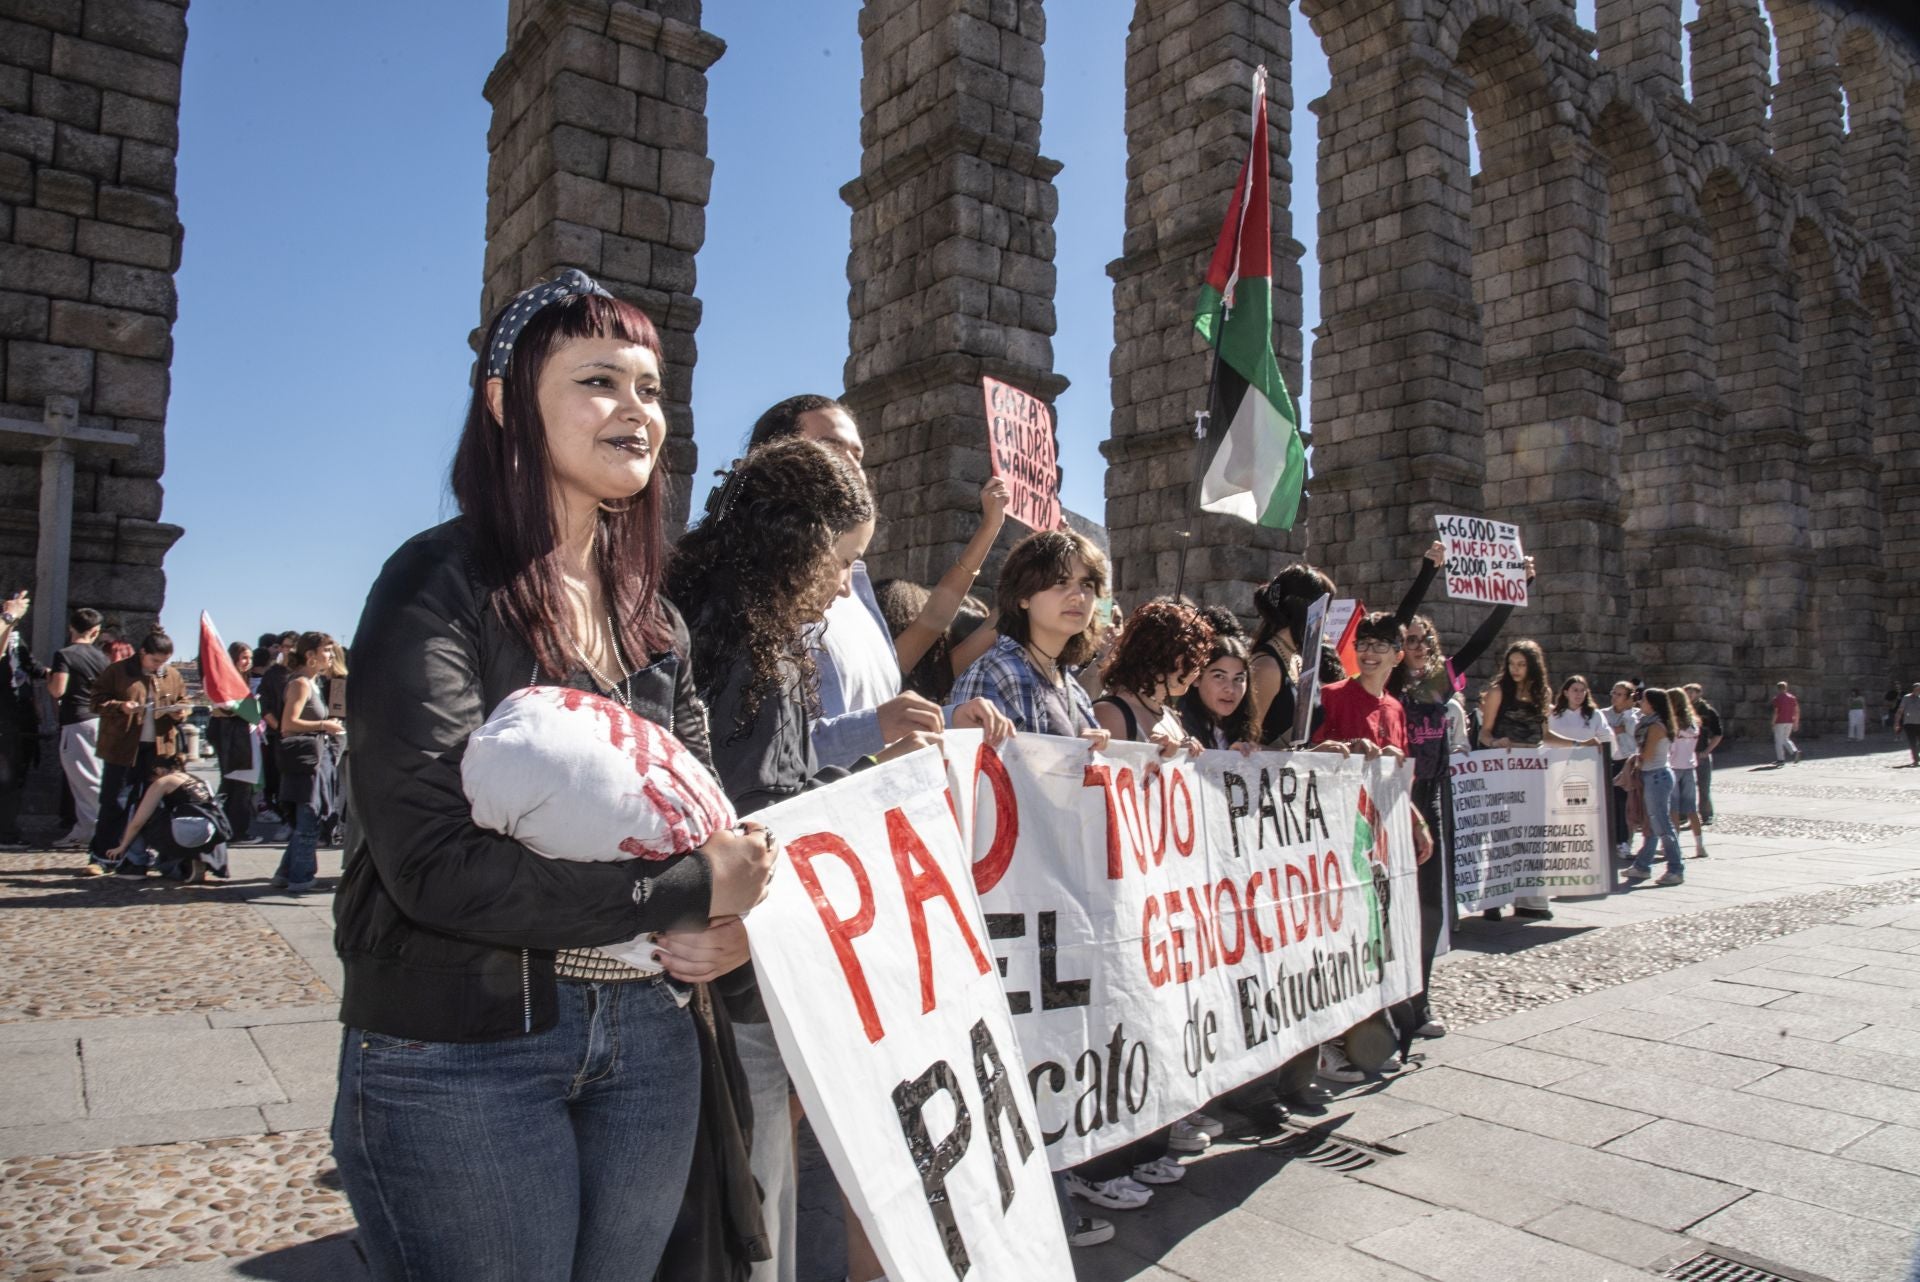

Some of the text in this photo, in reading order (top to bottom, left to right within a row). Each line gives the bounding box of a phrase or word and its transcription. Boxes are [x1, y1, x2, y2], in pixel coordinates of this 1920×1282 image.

[993, 416, 1054, 473] CHILDREN
[1013, 482, 1051, 528] UP TOO
[1451, 539, 1517, 559] MUERTOS
[1474, 572, 1525, 602] NIÑOS
[1482, 758, 1504, 772] EN
[1506, 758, 1549, 770] GAZA!
[1083, 762, 1196, 880] TODO
[1223, 767, 1330, 858] PARA
[1141, 850, 1343, 989] GENOCIDIO
[1183, 996, 1218, 1078] de
[1237, 928, 1384, 1051] Estudiantes
